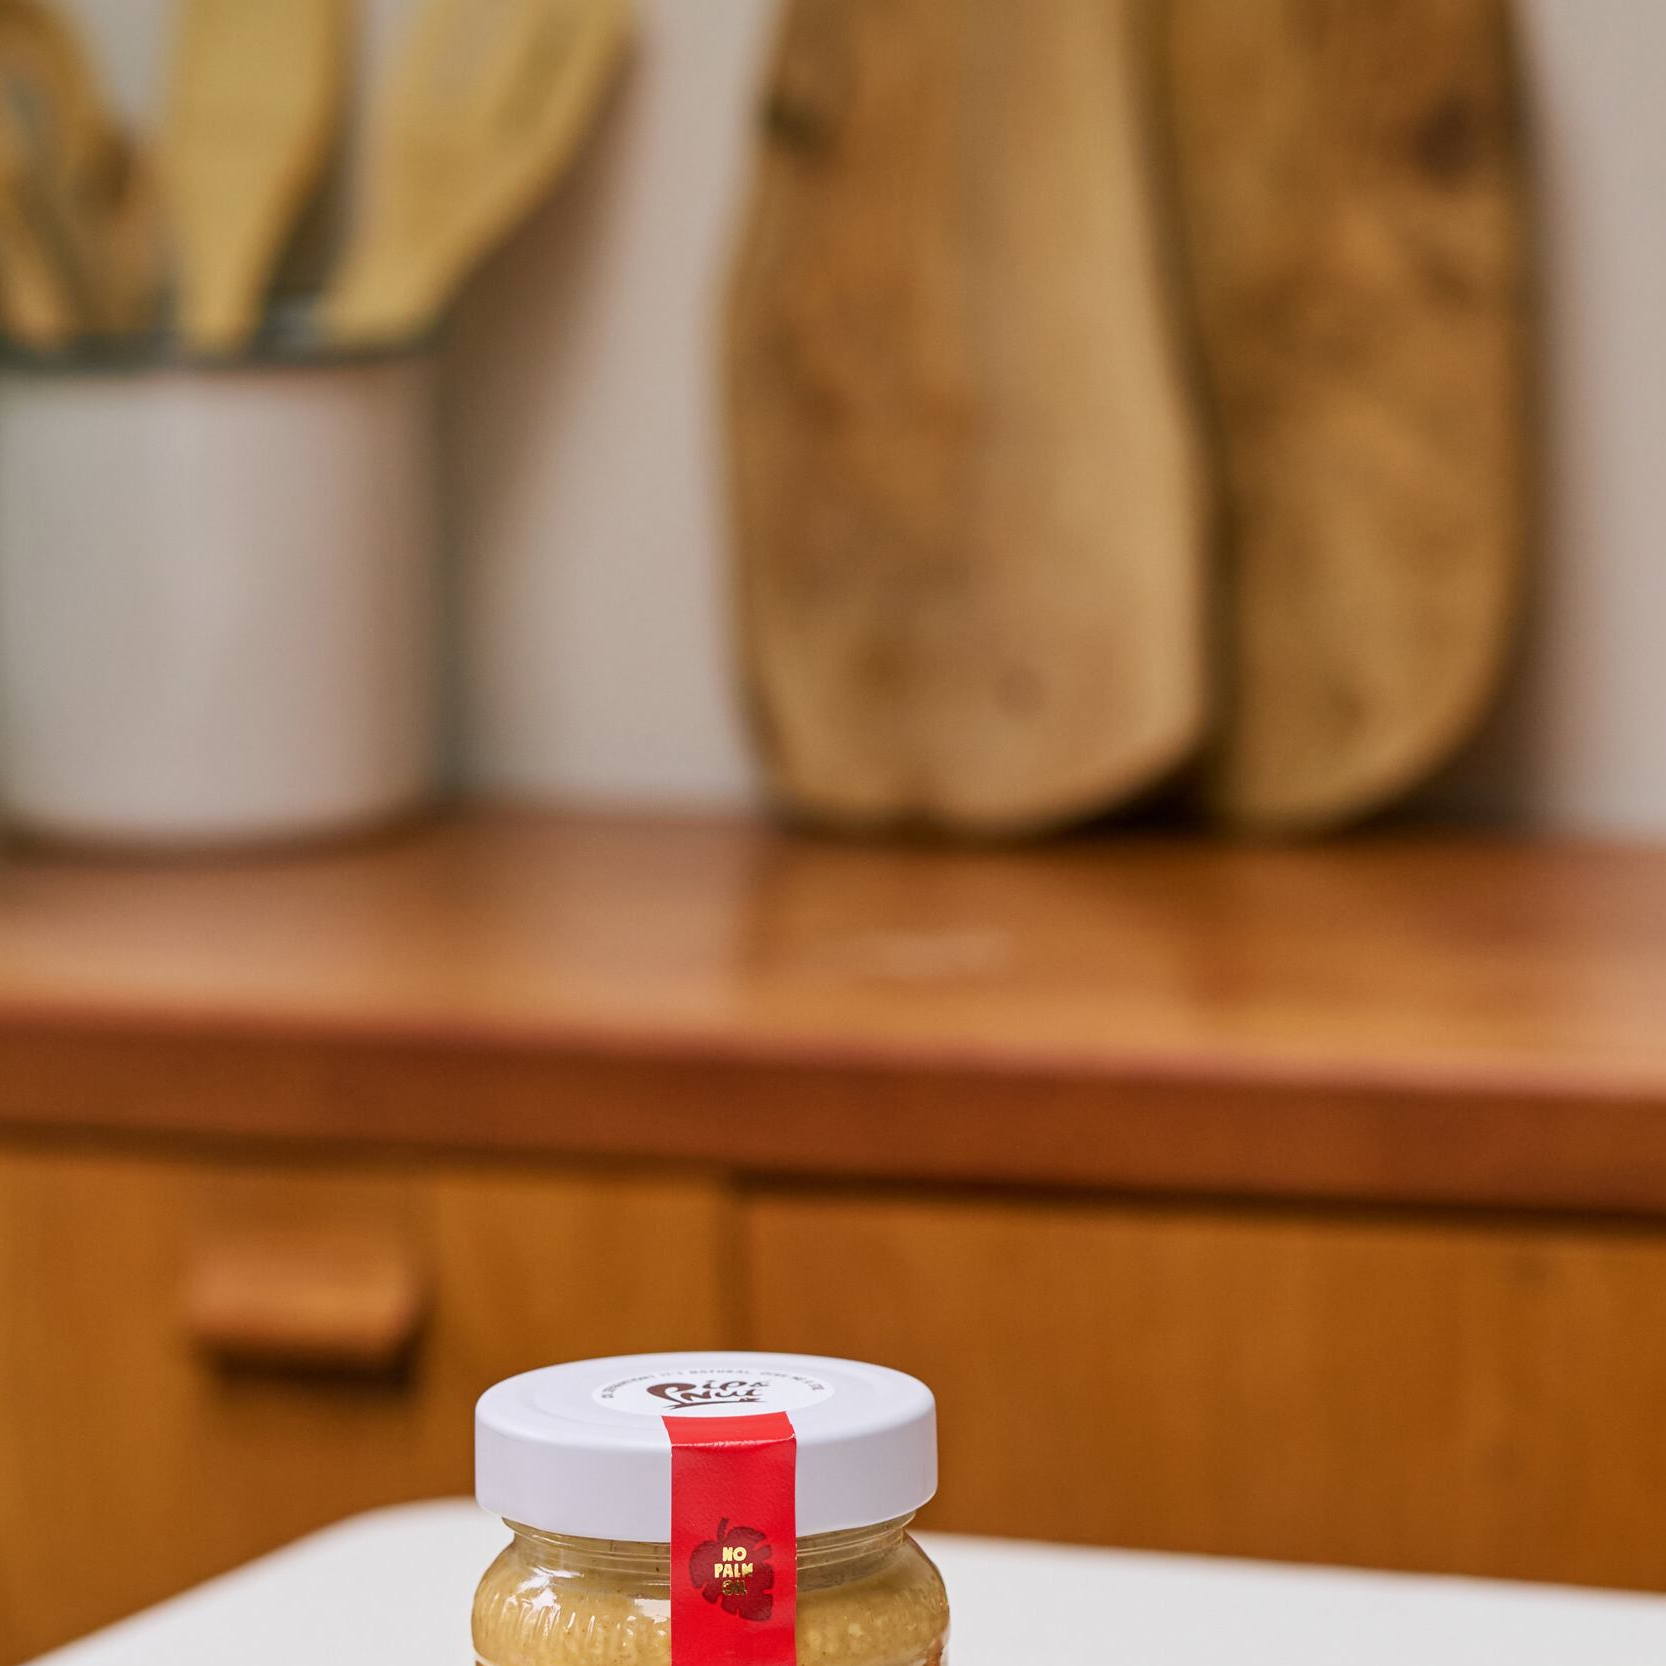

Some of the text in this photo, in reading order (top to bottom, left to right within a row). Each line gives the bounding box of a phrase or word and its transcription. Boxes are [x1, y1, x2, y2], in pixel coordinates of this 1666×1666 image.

[680, 1388, 763, 1401] Nut
[722, 1546, 747, 1562] NO
[714, 1562, 753, 1578] PALM
[722, 1579, 748, 1596] OIL
